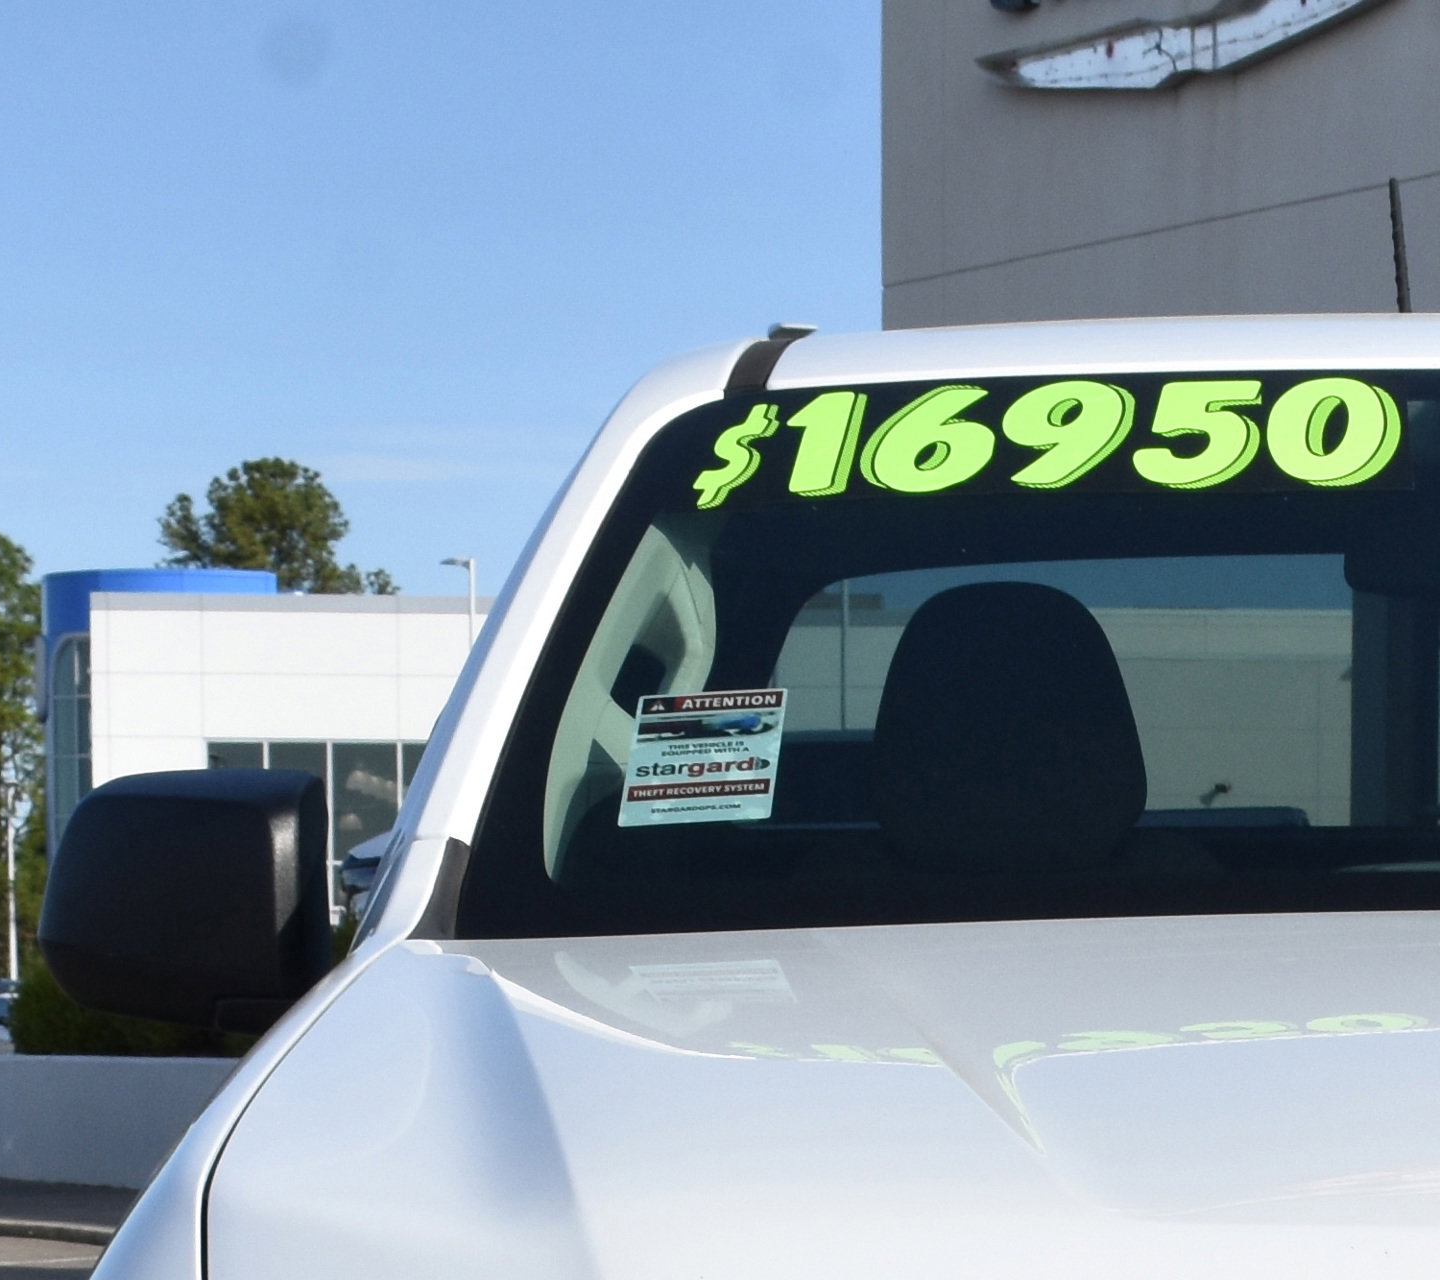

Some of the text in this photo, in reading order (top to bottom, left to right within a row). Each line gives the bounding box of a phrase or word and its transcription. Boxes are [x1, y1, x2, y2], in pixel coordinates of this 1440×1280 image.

[692, 376, 1402, 510] $16950
[682, 695, 776, 709] ATTENTION
[661, 749, 712, 757] EQUIPPED
[636, 757, 754, 777] stargard
[633, 783, 765, 798] THEFT RECOVERY SYSTEM
